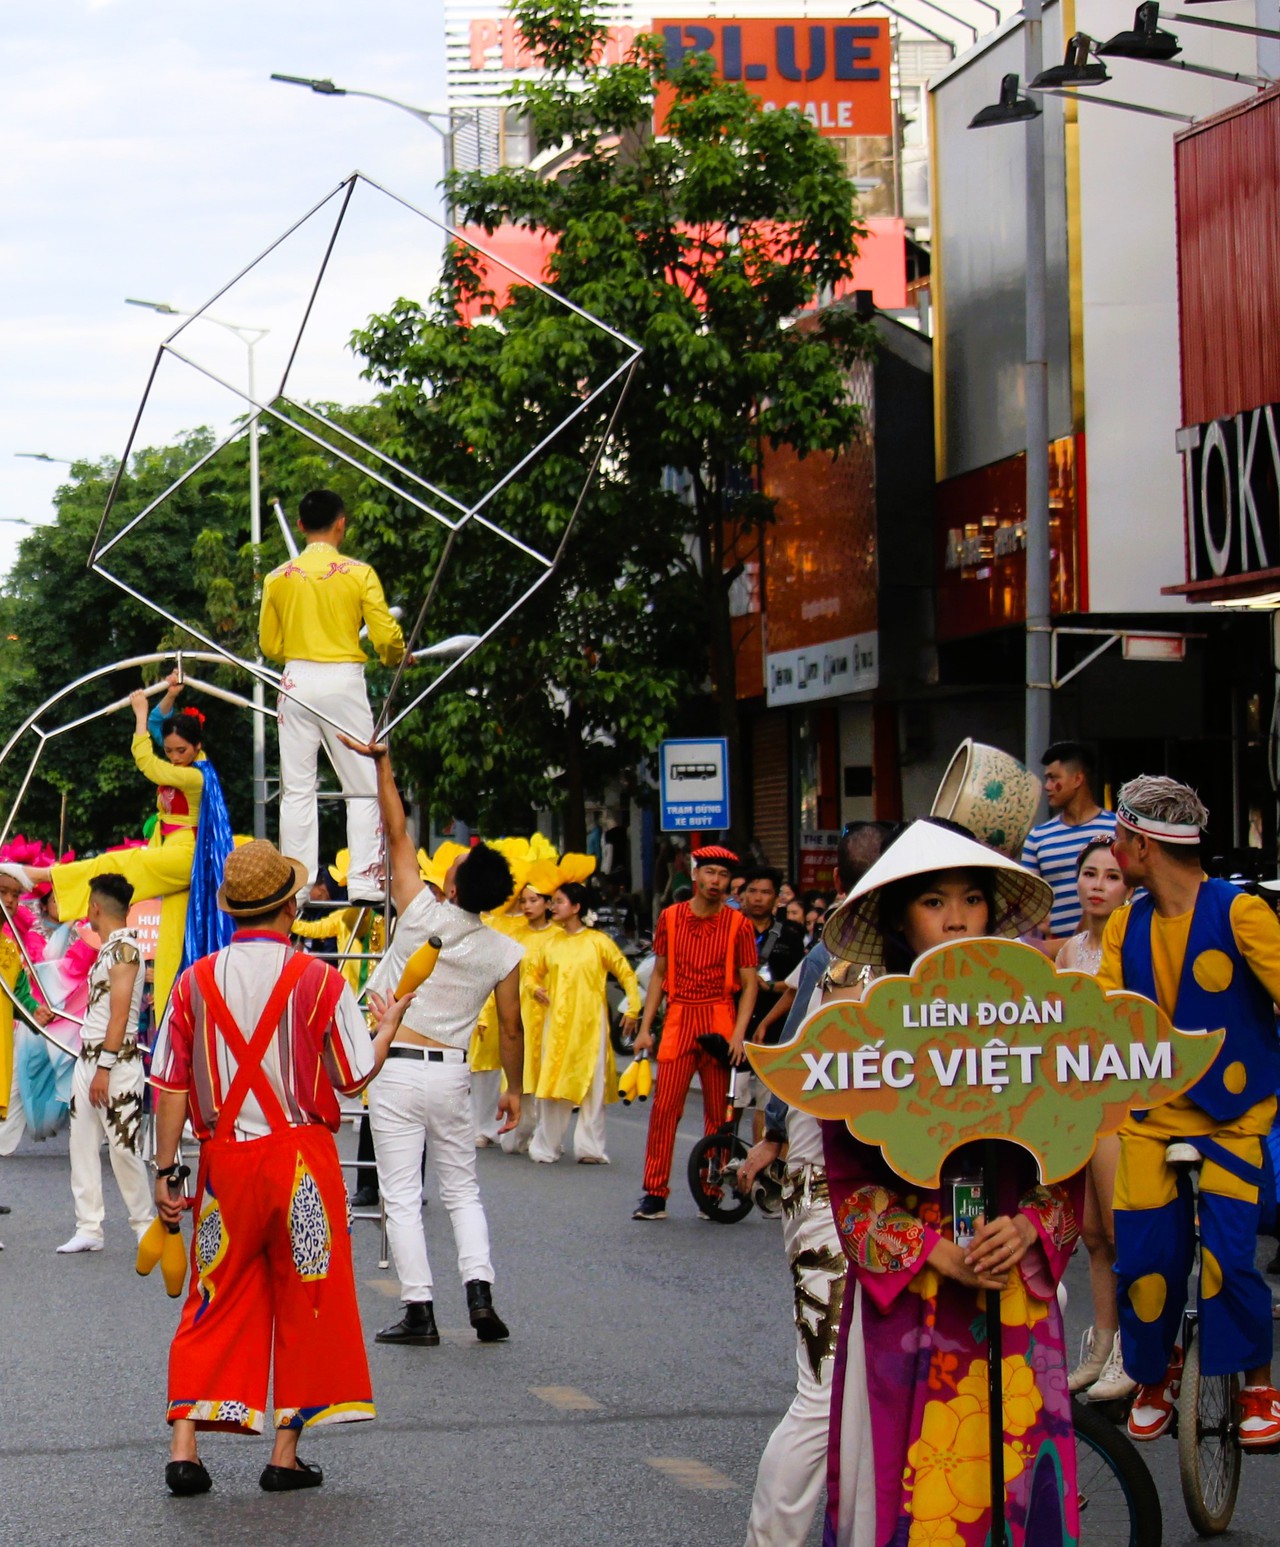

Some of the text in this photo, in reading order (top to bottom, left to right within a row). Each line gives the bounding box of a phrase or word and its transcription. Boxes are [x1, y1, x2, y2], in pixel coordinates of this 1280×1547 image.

[663, 25, 880, 81] BLUE
[675, 817, 687, 826] XE
[902, 997, 1063, 1028] LIÊN ĐOÀN
[801, 1038, 1172, 1093] XIẾC VIỆT NAM
